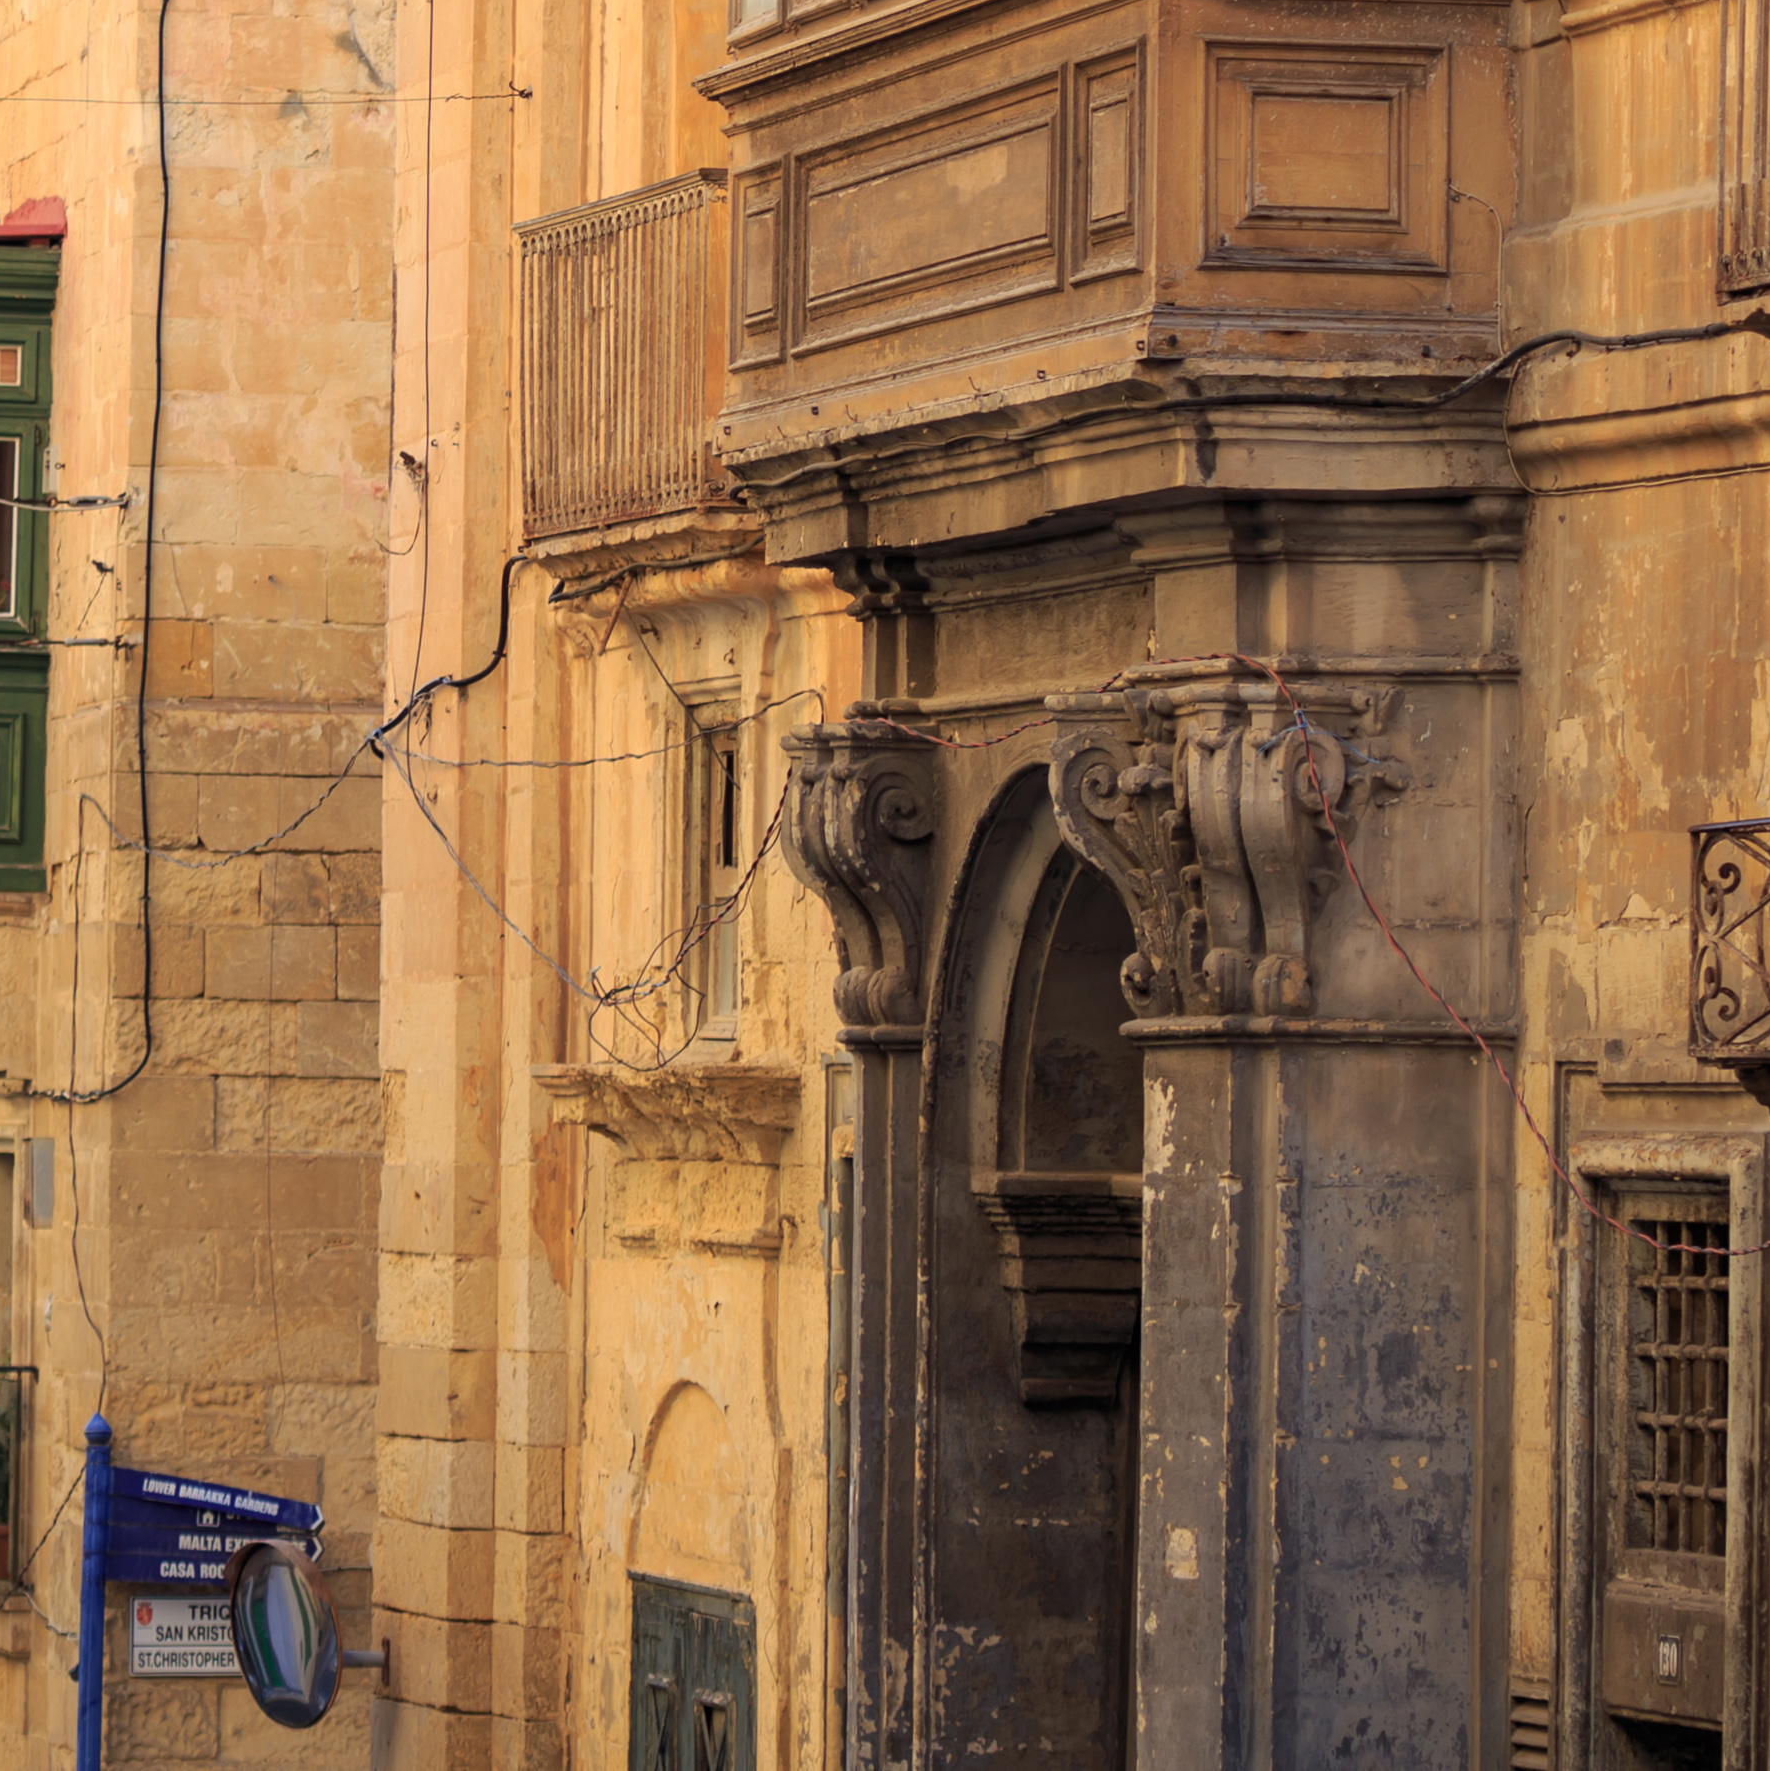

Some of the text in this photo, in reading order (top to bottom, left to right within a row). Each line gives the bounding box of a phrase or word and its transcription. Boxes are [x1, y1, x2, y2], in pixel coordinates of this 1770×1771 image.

[142, 1478, 279, 1516] LOWER BARRAKKA GARDENS
[179, 1535, 221, 1552] MALTA
[160, 1561, 195, 1578] CASA
[188, 1605, 230, 1620] TRIQ
[156, 1625, 183, 1641] SAN
[138, 1652, 235, 1667] ST.CHRISTOPHER
[1659, 1641, 1678, 1677] 130
